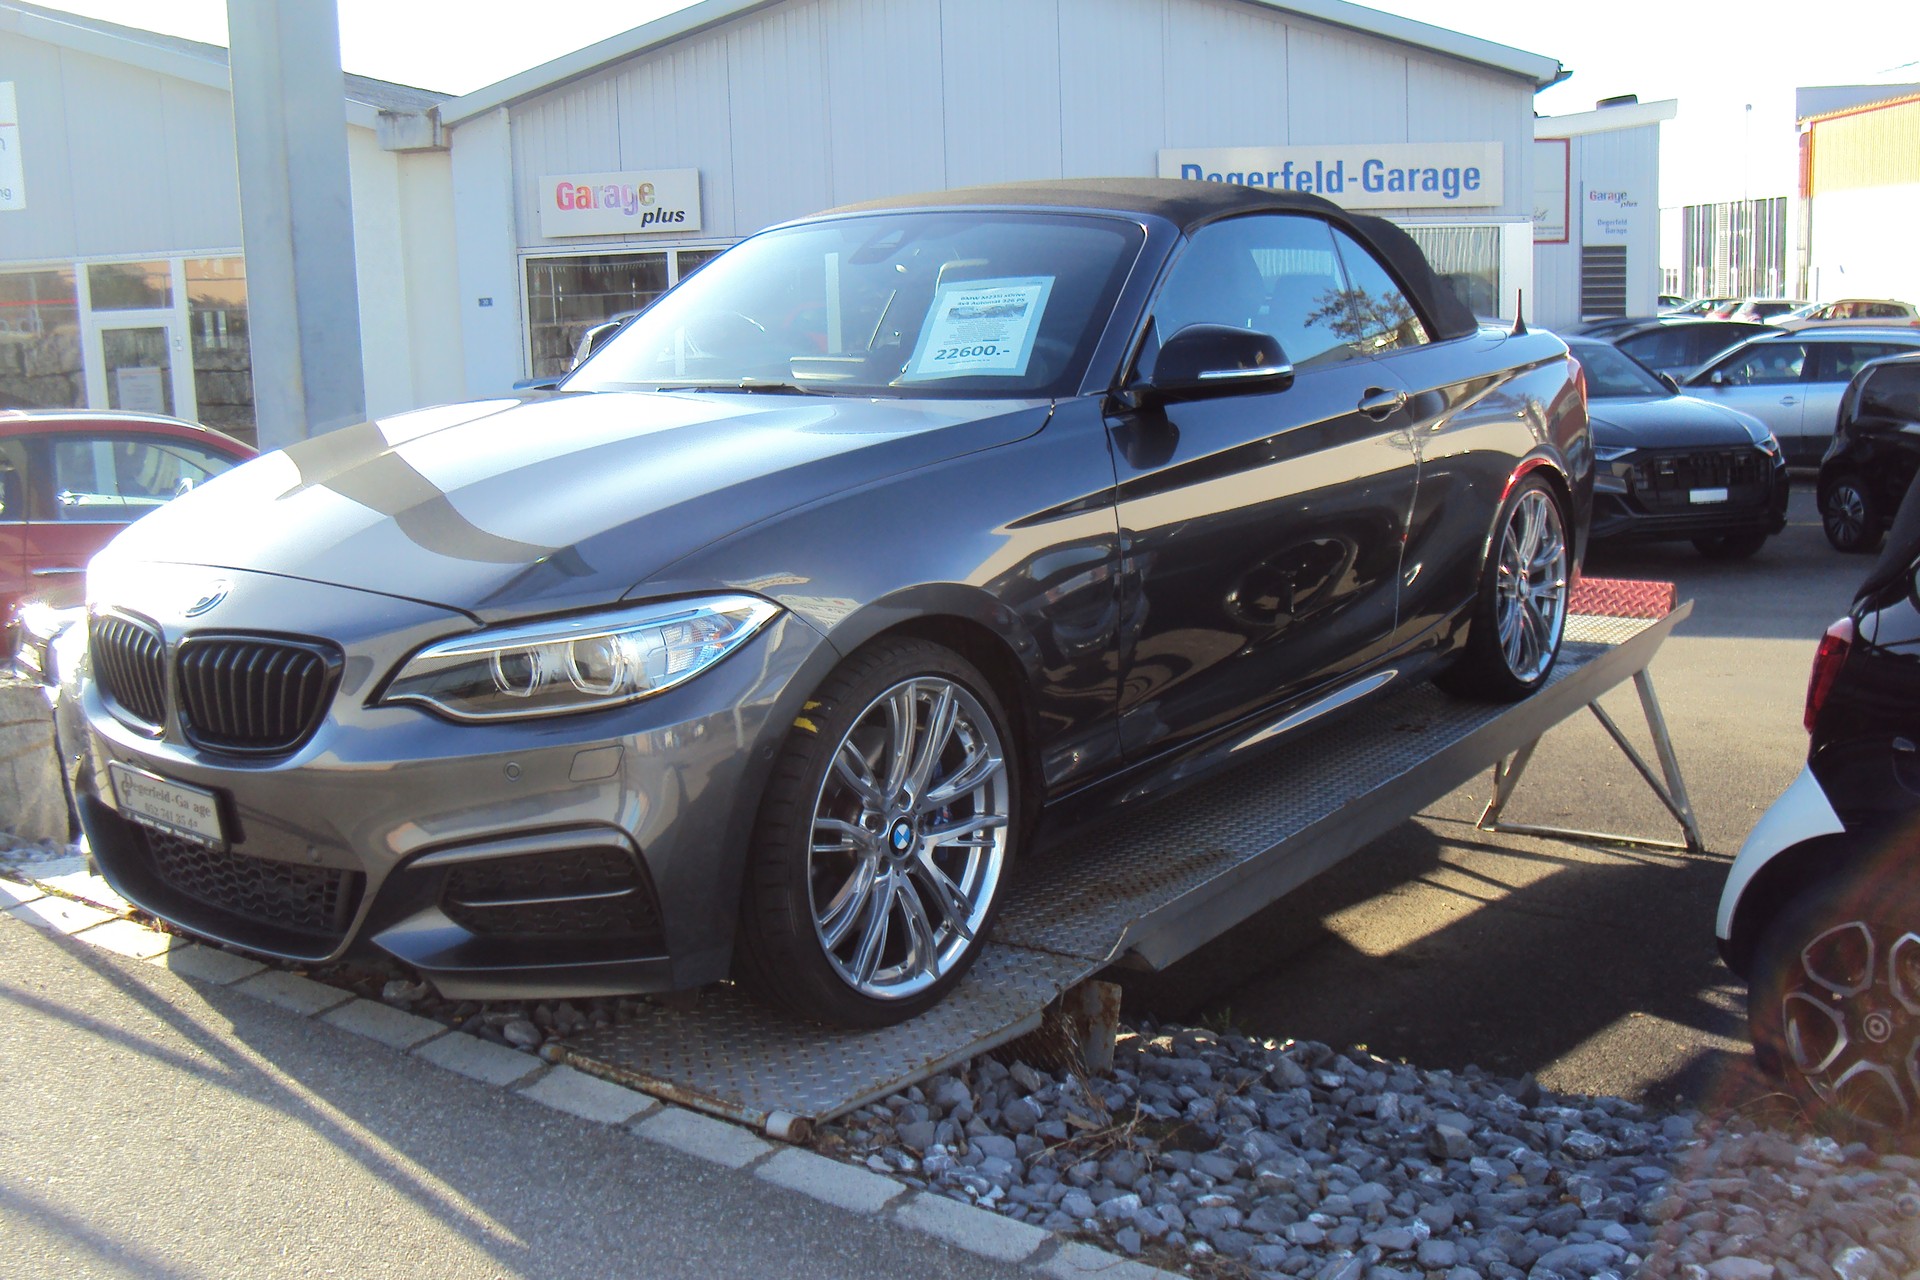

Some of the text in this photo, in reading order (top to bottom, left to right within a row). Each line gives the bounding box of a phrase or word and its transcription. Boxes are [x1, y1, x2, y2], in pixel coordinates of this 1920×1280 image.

[556, 181, 656, 216] Garage
[1589, 190, 1628, 203] Garage
[641, 207, 686, 228] plus
[934, 345, 1010, 361] 22600.-
